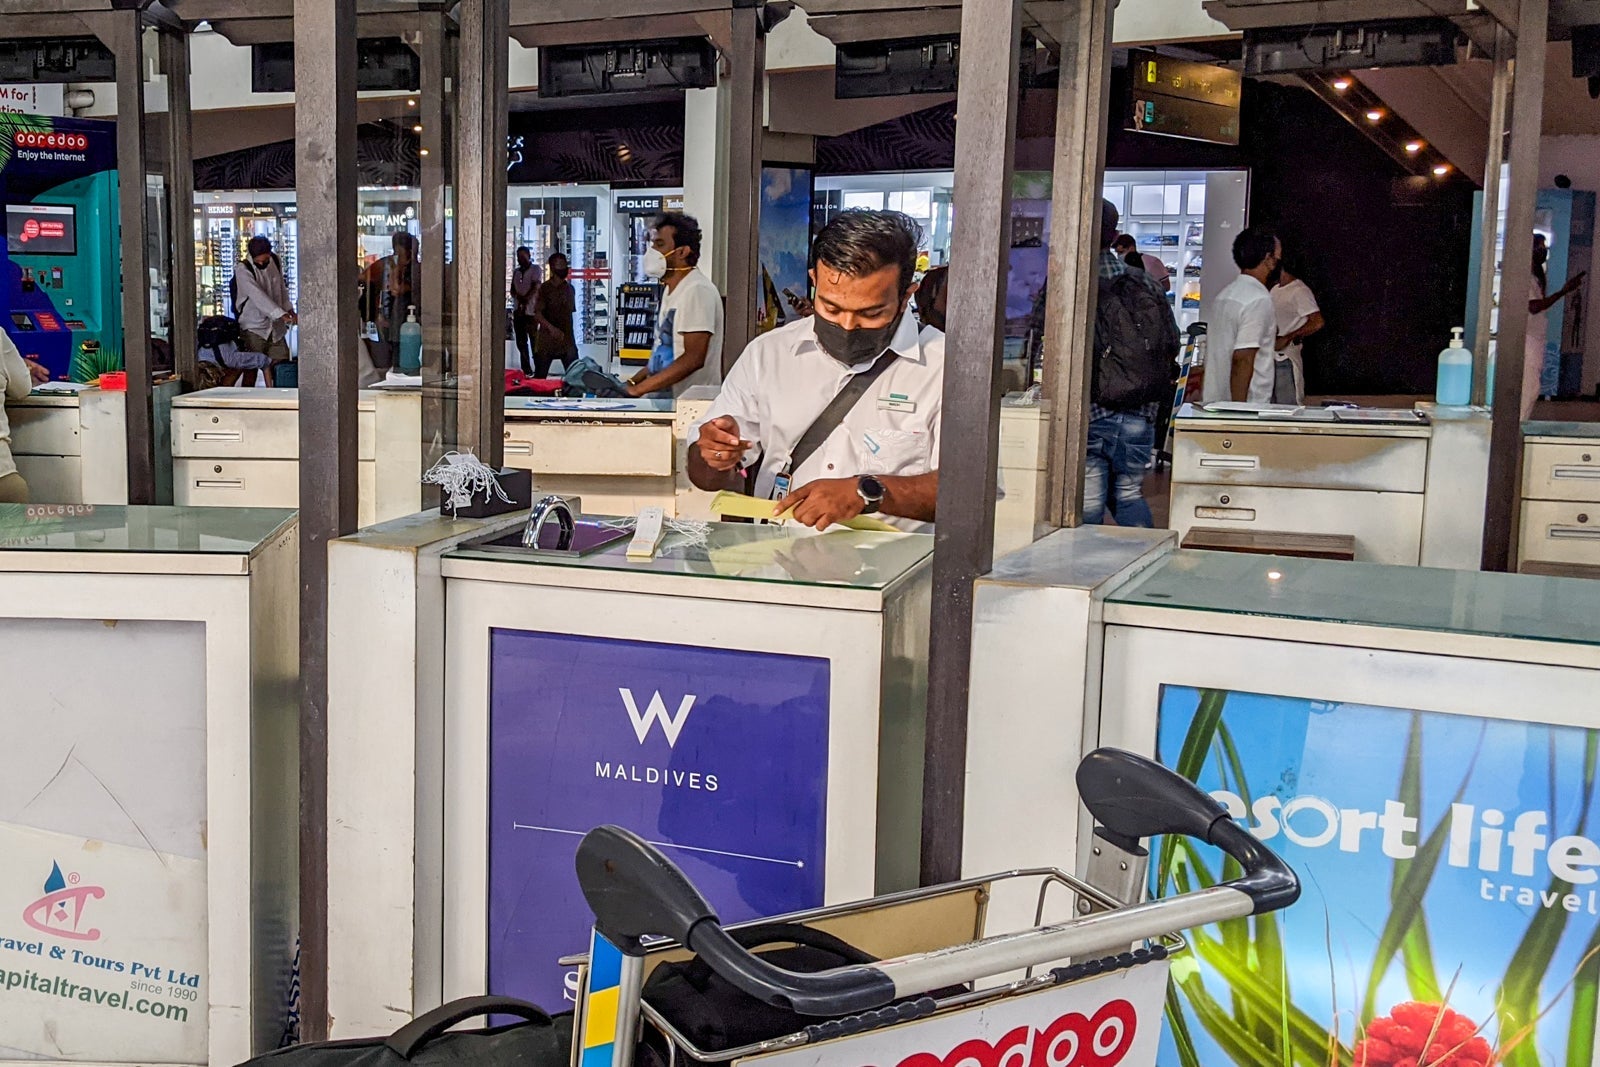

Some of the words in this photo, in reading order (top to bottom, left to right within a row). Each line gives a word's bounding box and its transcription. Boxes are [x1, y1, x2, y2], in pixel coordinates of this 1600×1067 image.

[11, 88, 29, 101] for
[16, 132, 87, 148] ooredoo
[17, 150, 39, 160] Enjoy
[40, 150, 53, 160] the
[54, 152, 85, 161] Internet
[560, 210, 585, 218] SUUNTO
[619, 200, 659, 208] POLICE
[618, 687, 697, 749] W
[595, 762, 719, 791] MALDIVES
[1208, 790, 1418, 860] esort
[1447, 803, 1600, 885] life
[1480, 878, 1598, 915] travel
[50, 946, 66, 960] &
[72, 950, 125, 972] Tours
[130, 962, 162, 981] Pvt
[167, 969, 200, 988] Ltd
[130, 979, 163, 995] since
[167, 985, 198, 1002] 1990
